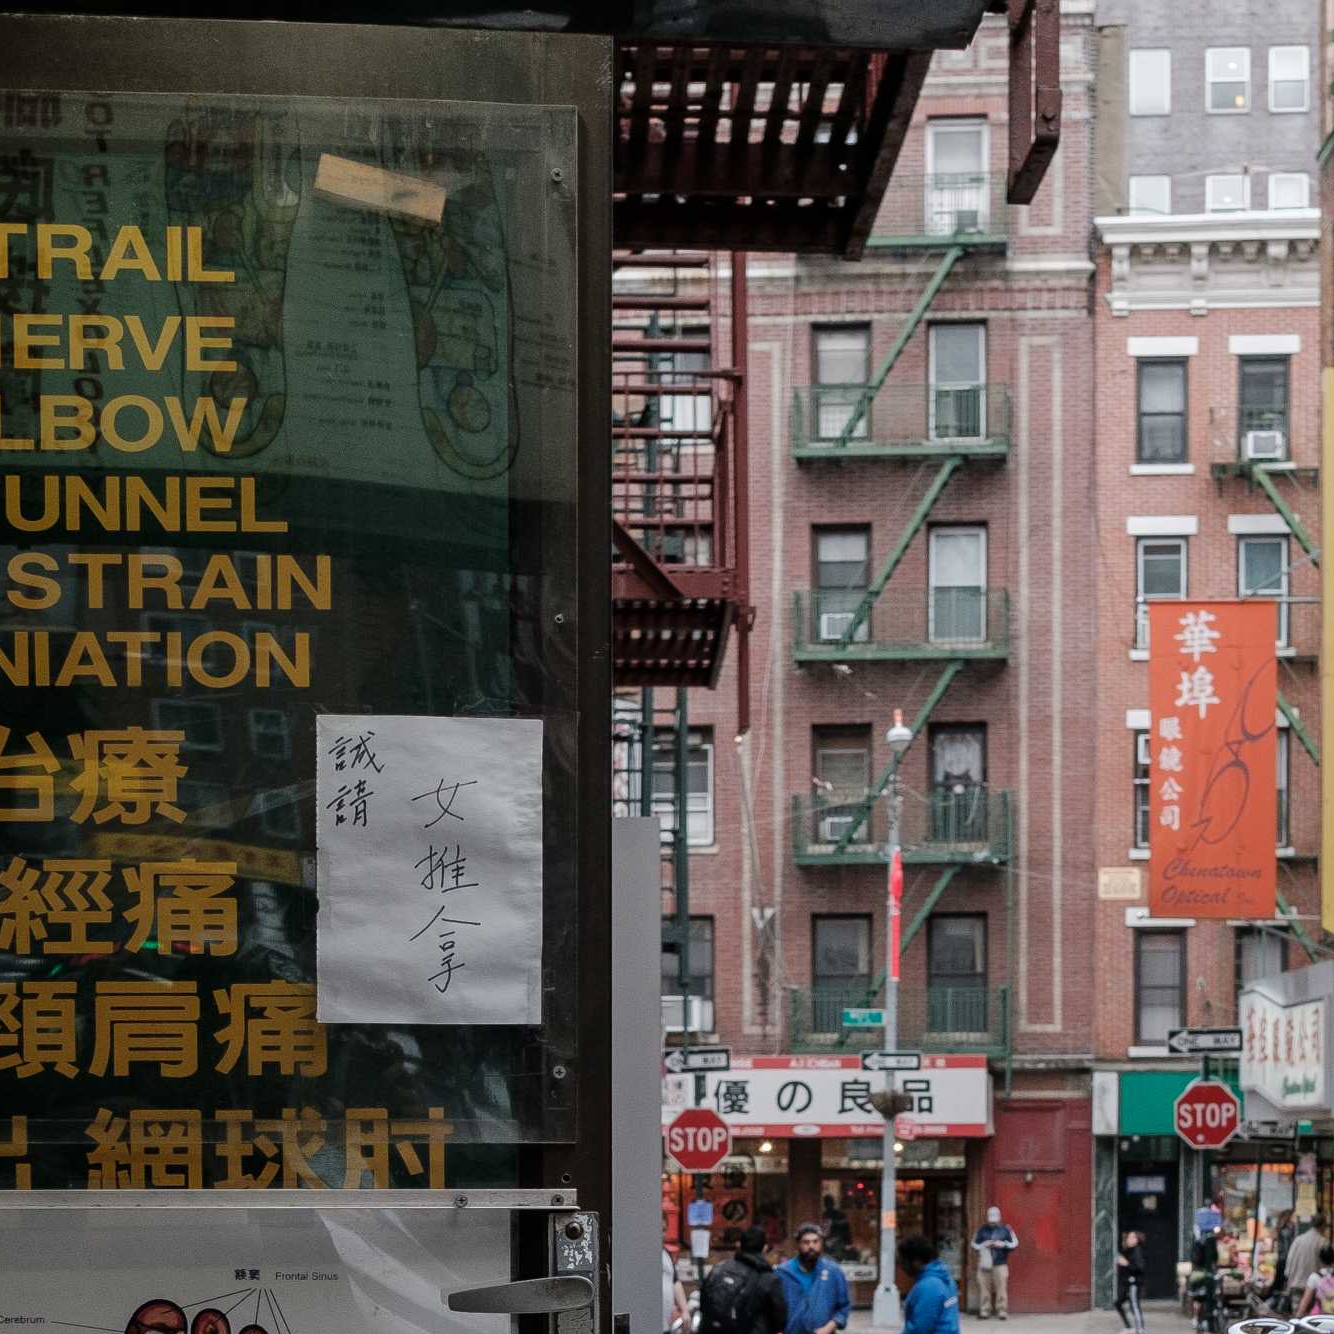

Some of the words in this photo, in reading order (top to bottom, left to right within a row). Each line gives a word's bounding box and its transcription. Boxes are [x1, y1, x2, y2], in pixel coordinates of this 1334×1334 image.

[7, 553, 331, 610] STRAIN
[1173, 610, 1221, 720] 華埠
[1213, 1035, 1236, 1047] WAY
[1178, 1103, 1236, 1128] STOP
[87, 1107, 451, 1191] 網球肘
[670, 1126, 727, 1152] STOP
[275, 1272, 308, 1280] Frontal
[312, 1272, 339, 1281] Sinus
